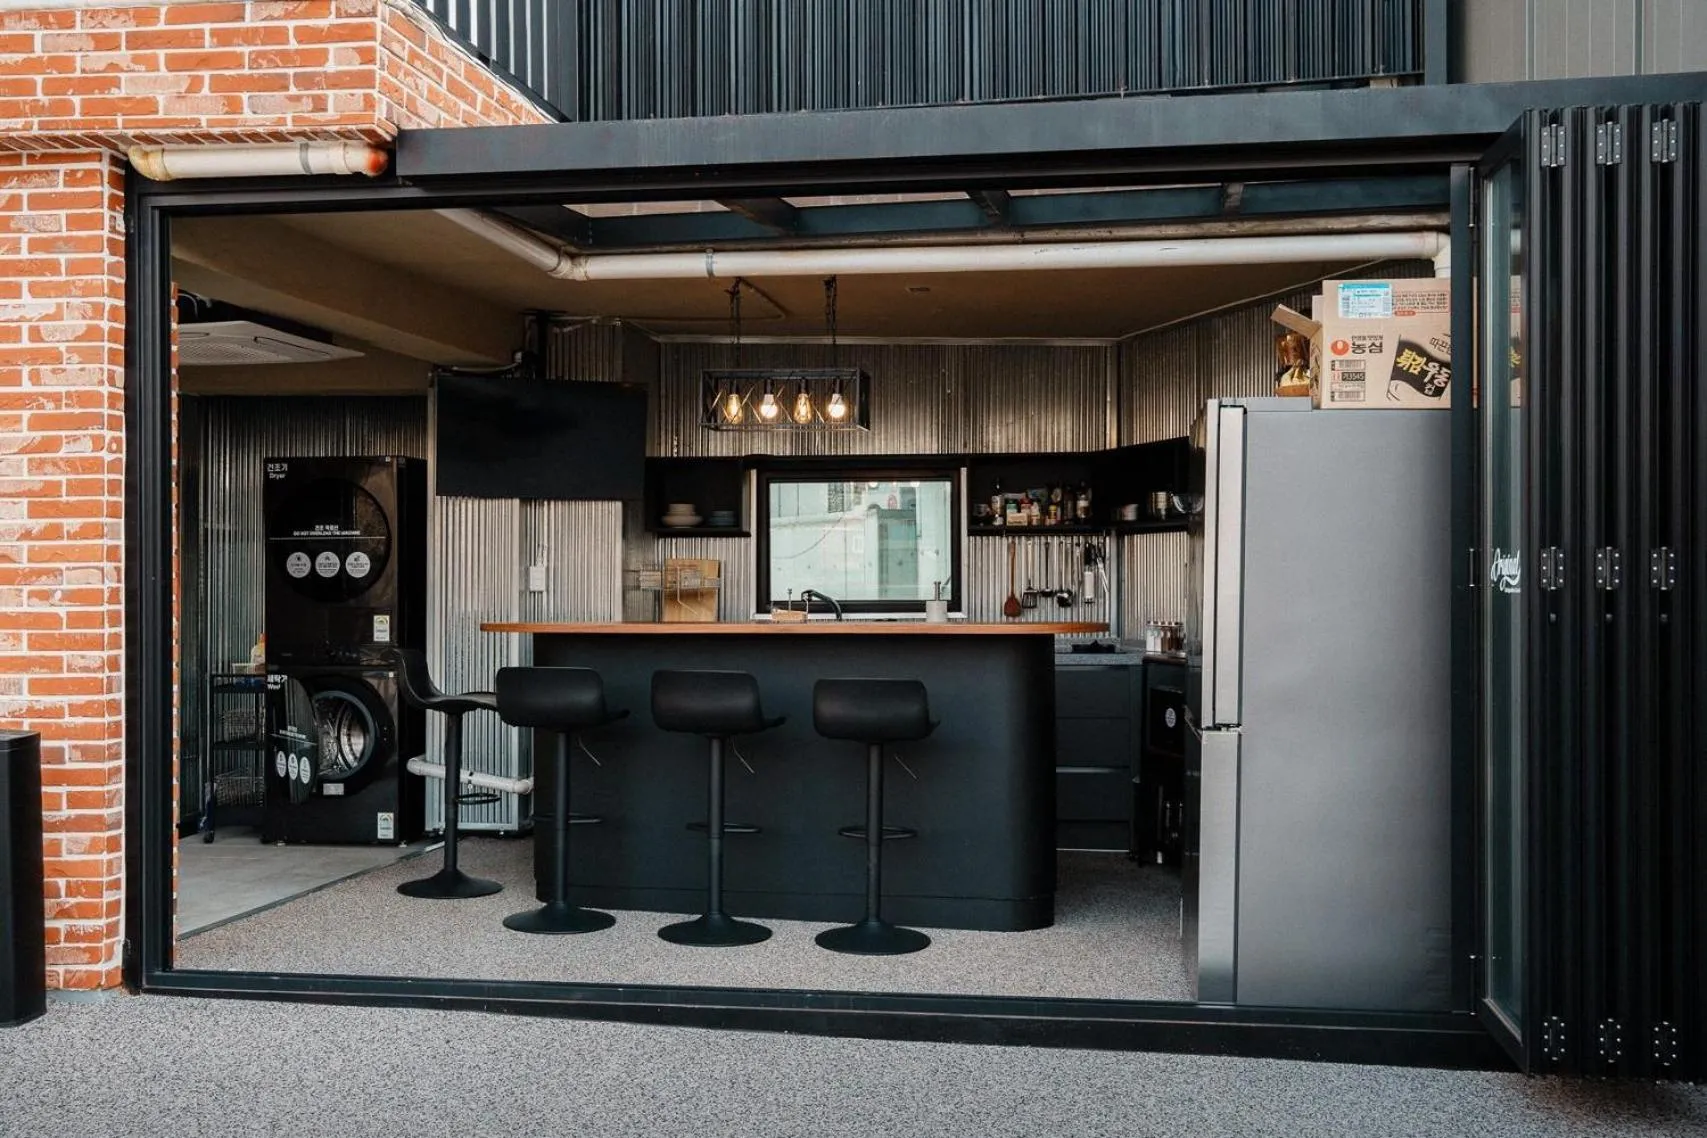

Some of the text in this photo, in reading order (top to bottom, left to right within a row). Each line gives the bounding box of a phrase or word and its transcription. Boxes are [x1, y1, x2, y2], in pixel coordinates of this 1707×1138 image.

[1351, 342, 1383, 355] 농심
[266, 463, 288, 472] 건조기
[269, 472, 286, 480] Dryer
